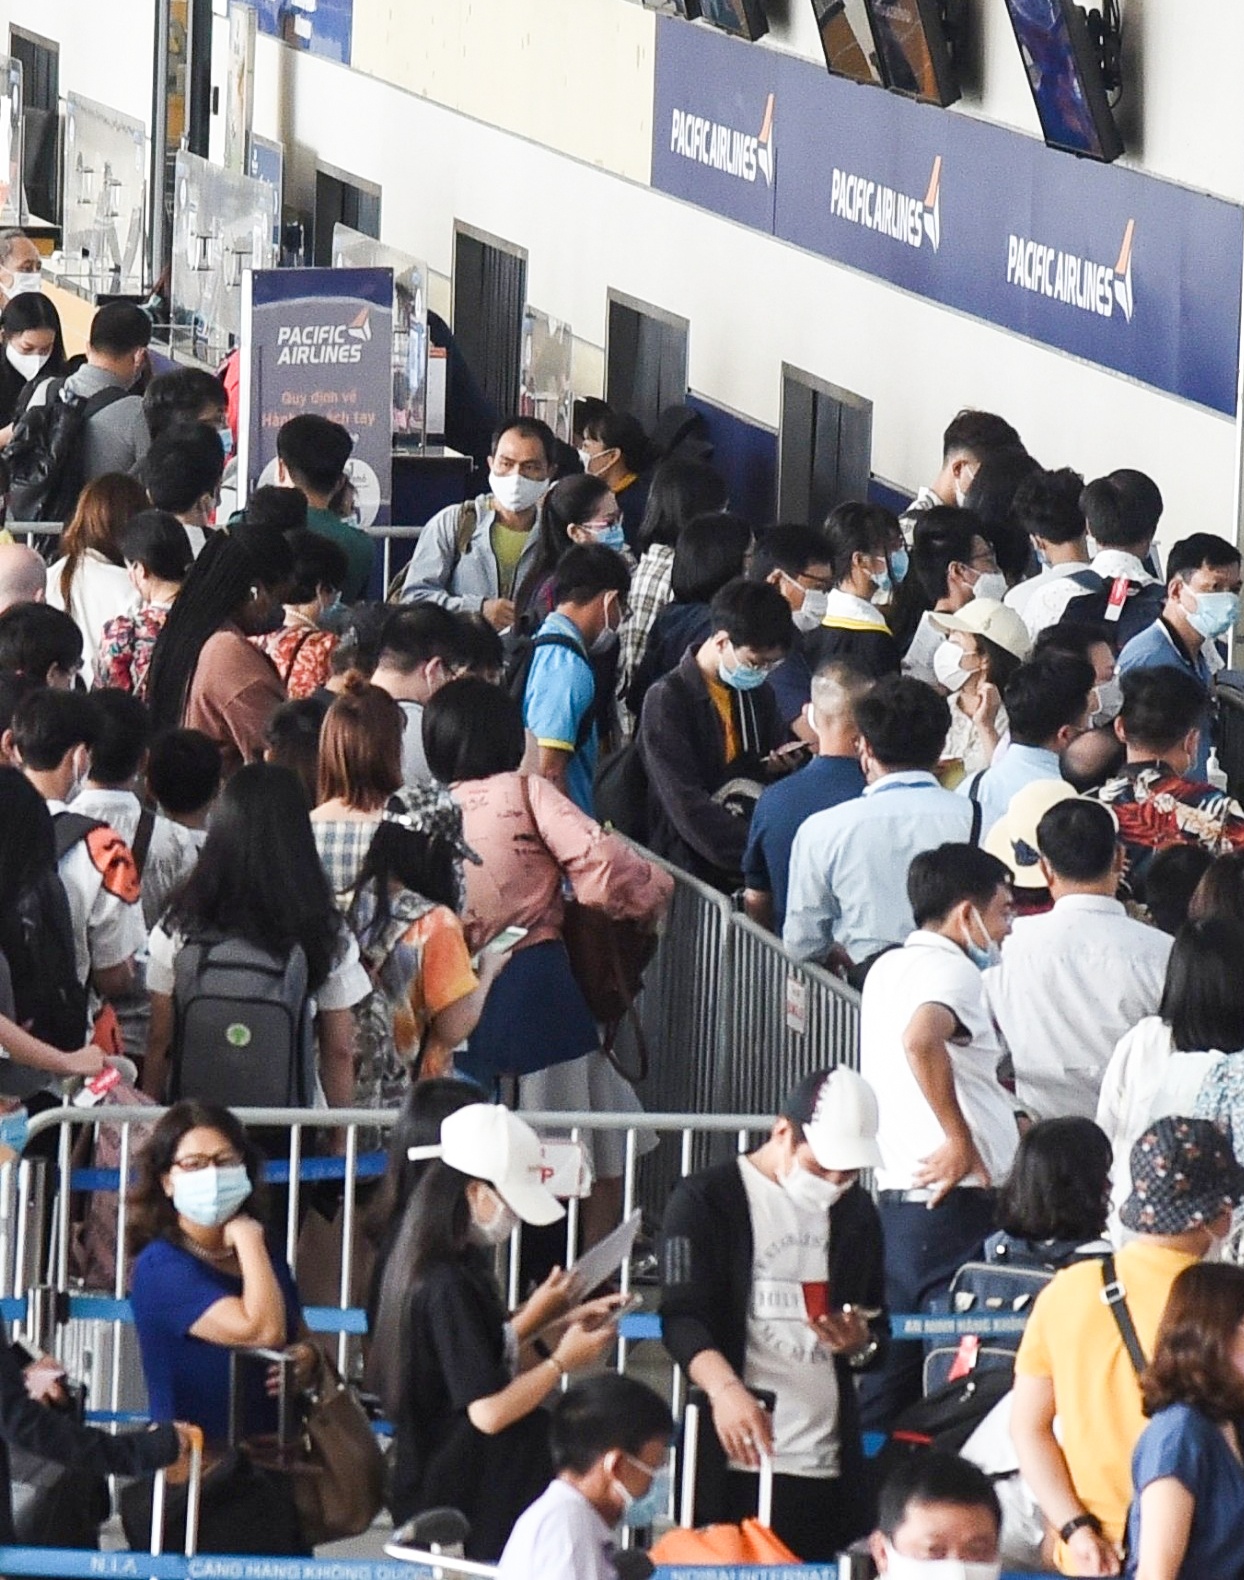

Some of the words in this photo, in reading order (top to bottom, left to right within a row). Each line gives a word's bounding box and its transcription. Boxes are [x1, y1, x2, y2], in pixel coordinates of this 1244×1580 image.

[670, 108, 711, 166] PACIFIC
[708, 122, 758, 182] AIRLINES
[830, 167, 875, 228] PACIFIC
[872, 184, 923, 248] AIRLINES
[1006, 234, 1055, 298] PACIFIC
[1053, 250, 1114, 317] AIRLINES
[276, 344, 362, 365] AIRLINES
[277, 325, 347, 345] PACIFIC
